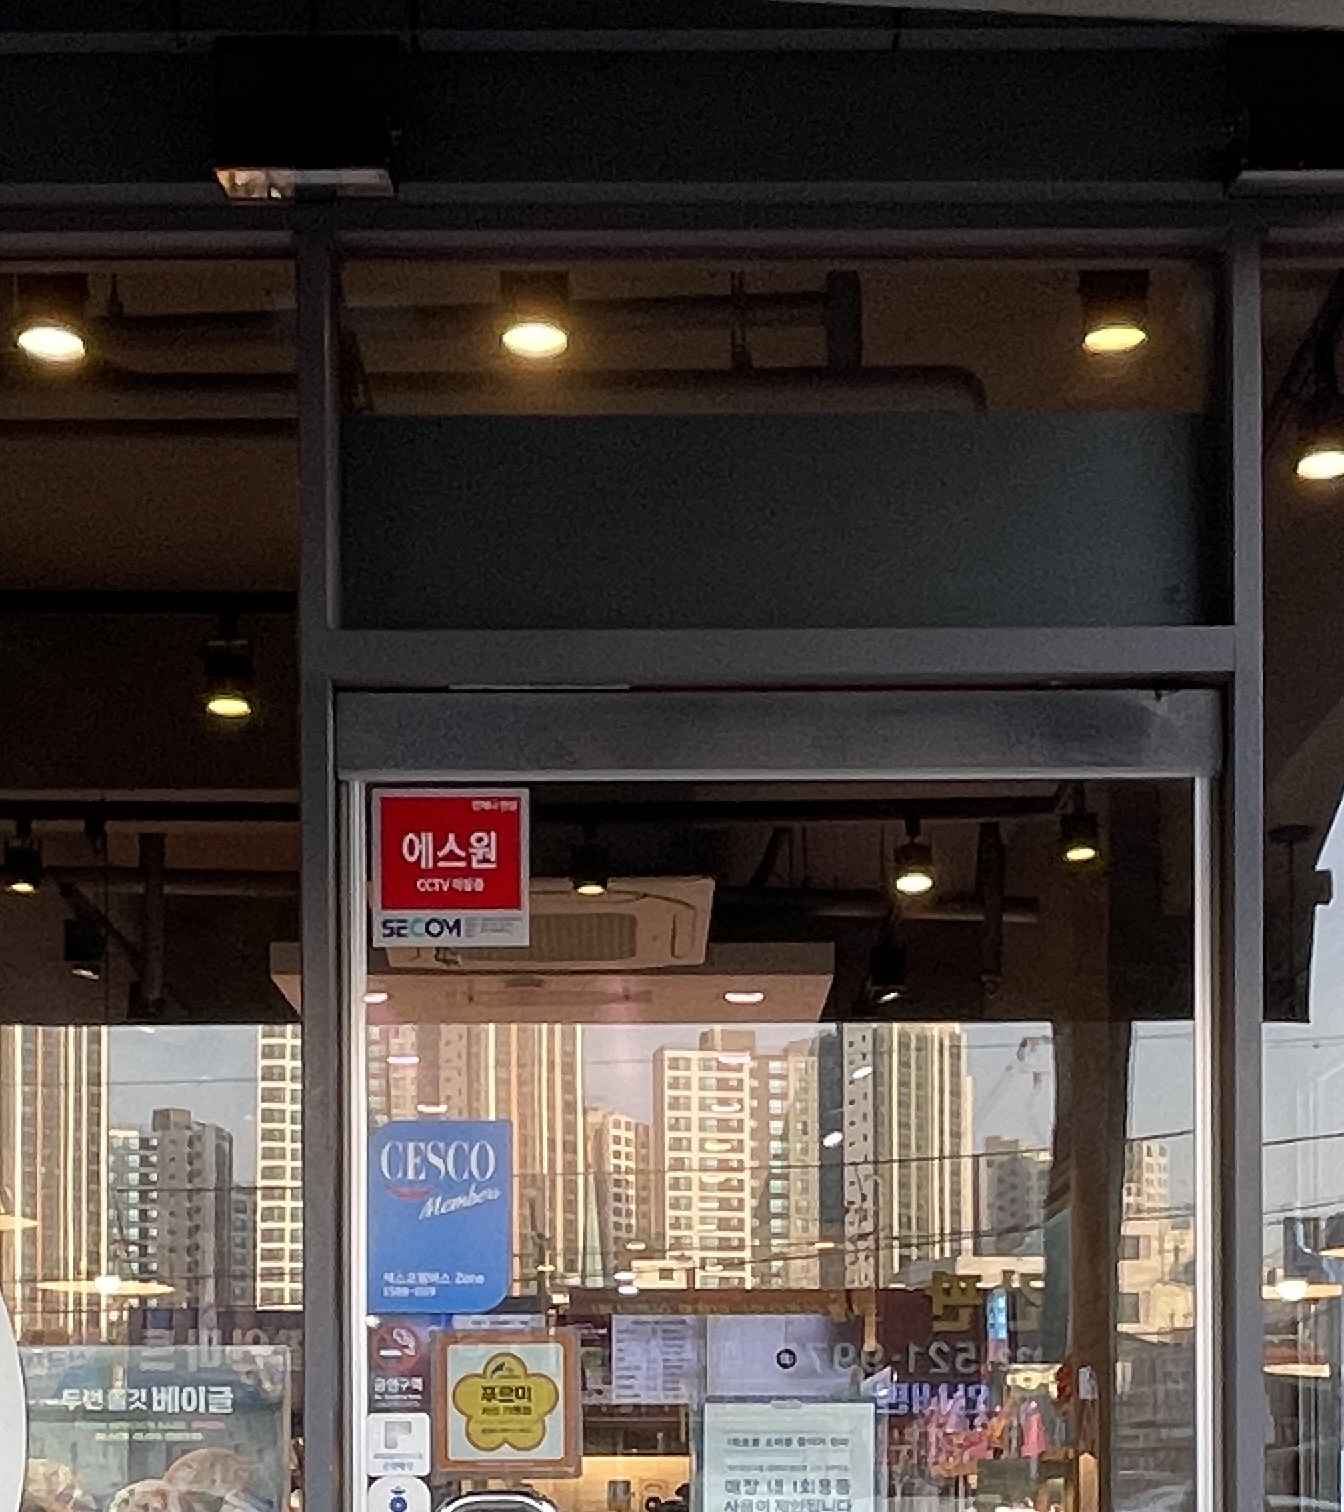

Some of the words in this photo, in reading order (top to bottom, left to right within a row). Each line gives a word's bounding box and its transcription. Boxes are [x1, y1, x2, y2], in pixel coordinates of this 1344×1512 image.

[402, 831, 497, 870] 에스원
[382, 918, 461, 938] SECOM
[381, 1140, 496, 1182] CESCO
[151, 1385, 234, 1414] 베이글
